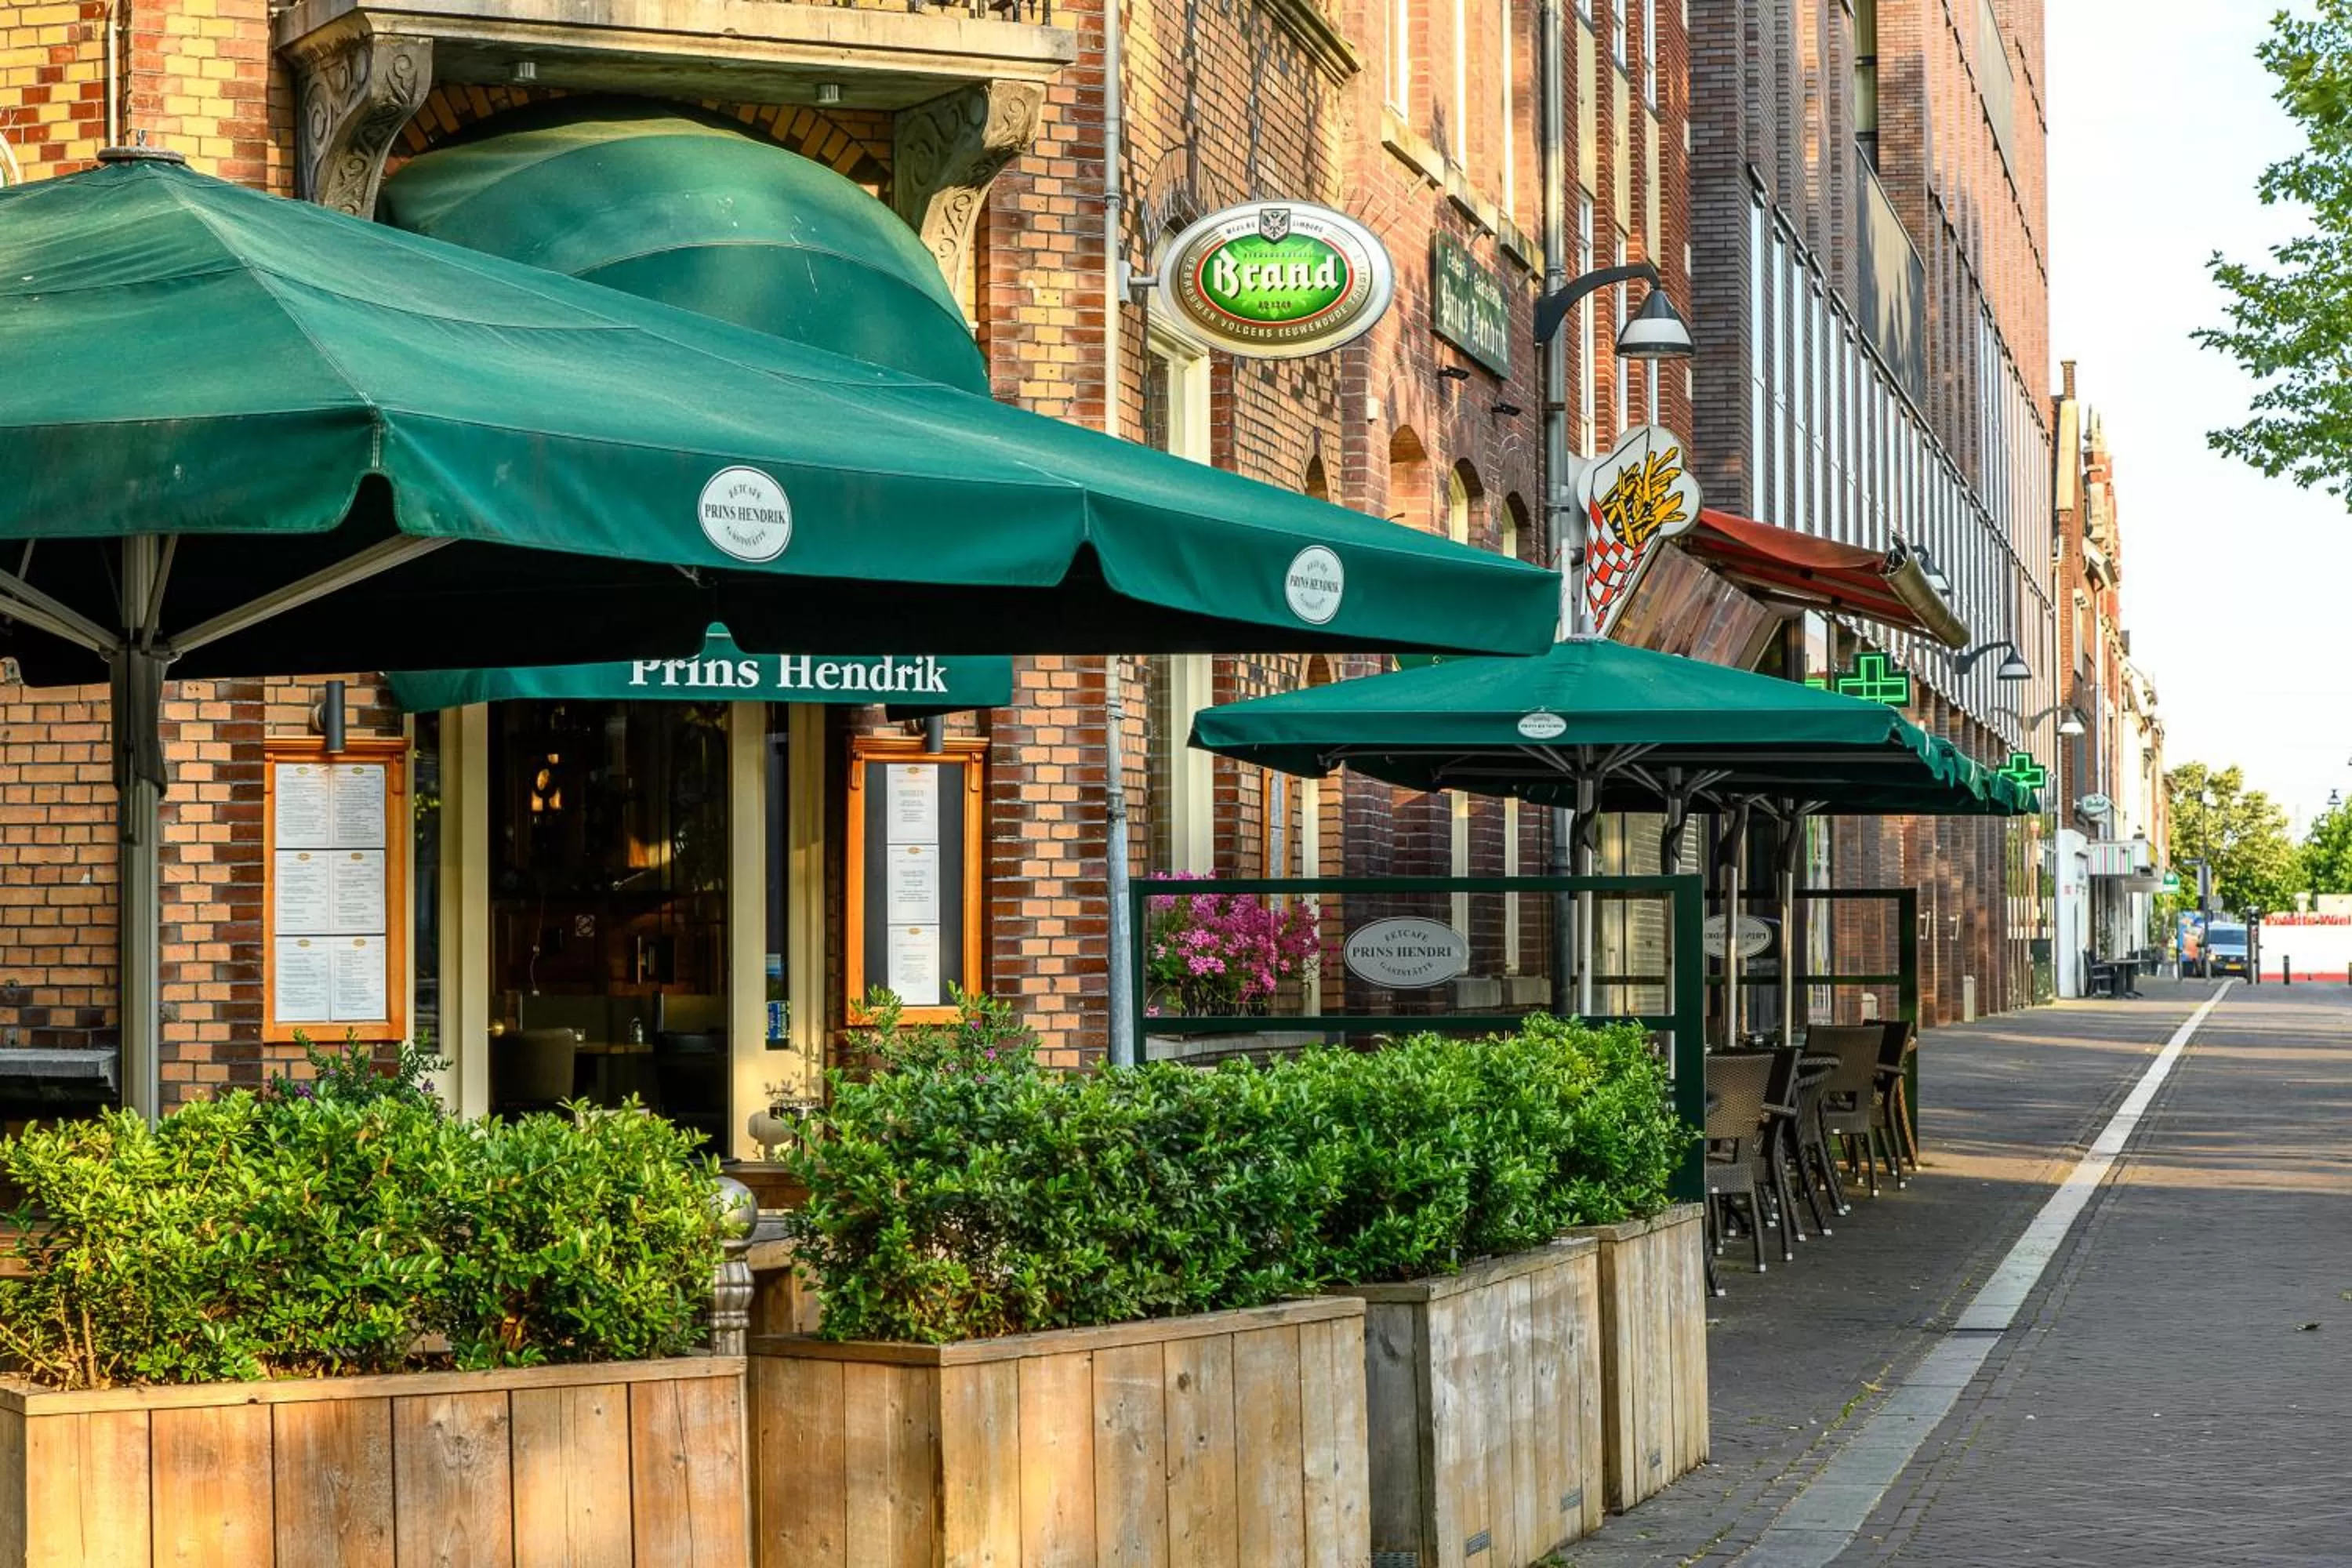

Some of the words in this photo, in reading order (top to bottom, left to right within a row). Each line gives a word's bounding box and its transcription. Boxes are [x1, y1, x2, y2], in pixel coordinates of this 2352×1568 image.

[1213, 248, 1340, 299] Brand
[1221, 319, 1273, 338] VOLGENS
[705, 503, 736, 520] PRINS
[738, 506, 786, 524] HENDRIK
[628, 654, 760, 688] Prins
[776, 653, 948, 693] Hendrik
[1352, 946, 1393, 958] PRINS
[1397, 946, 1461, 958] HENDRI
